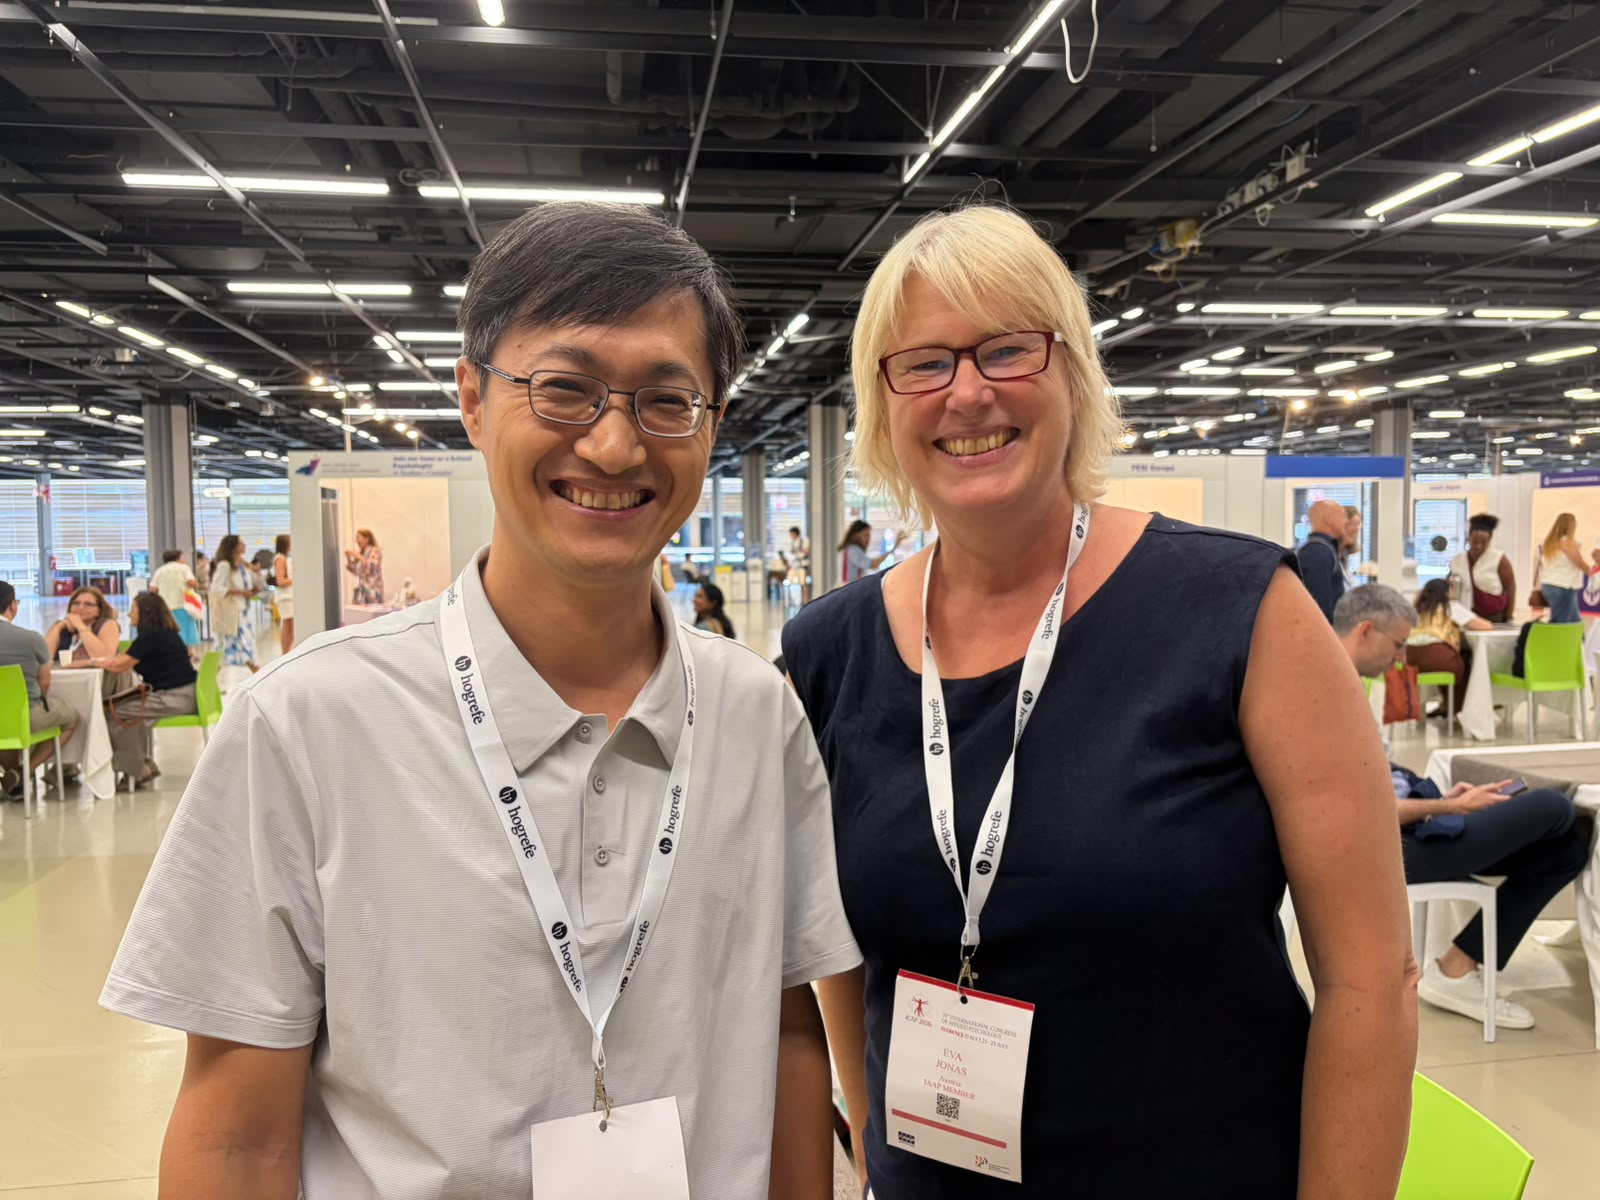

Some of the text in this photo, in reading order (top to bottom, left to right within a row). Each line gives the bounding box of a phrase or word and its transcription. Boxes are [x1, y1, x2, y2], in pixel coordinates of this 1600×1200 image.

[460, 674, 483, 725] hogrefe
[929, 698, 944, 739] hogrefe
[507, 805, 537, 858] hogrefe
[664, 785, 682, 834] hogrefe
[936, 808, 953, 855] hogrefe
[981, 810, 1002, 858] hogrefe
[559, 940, 582, 994] hogrefe
[625, 920, 650, 972] hogrefe
[949, 1019, 968, 1031] APPLIED
[968, 1024, 1002, 1039] PSYCHOLOGY
[950, 1014, 990, 1031] INTERNATIONAL
[990, 1024, 1017, 1038] CONGRESS
[936, 1059, 967, 1076] JONAS
[943, 1048, 962, 1062] EVA
[923, 1078, 976, 1100] IAAP MEMBER
[939, 1075, 962, 1088] Austria
